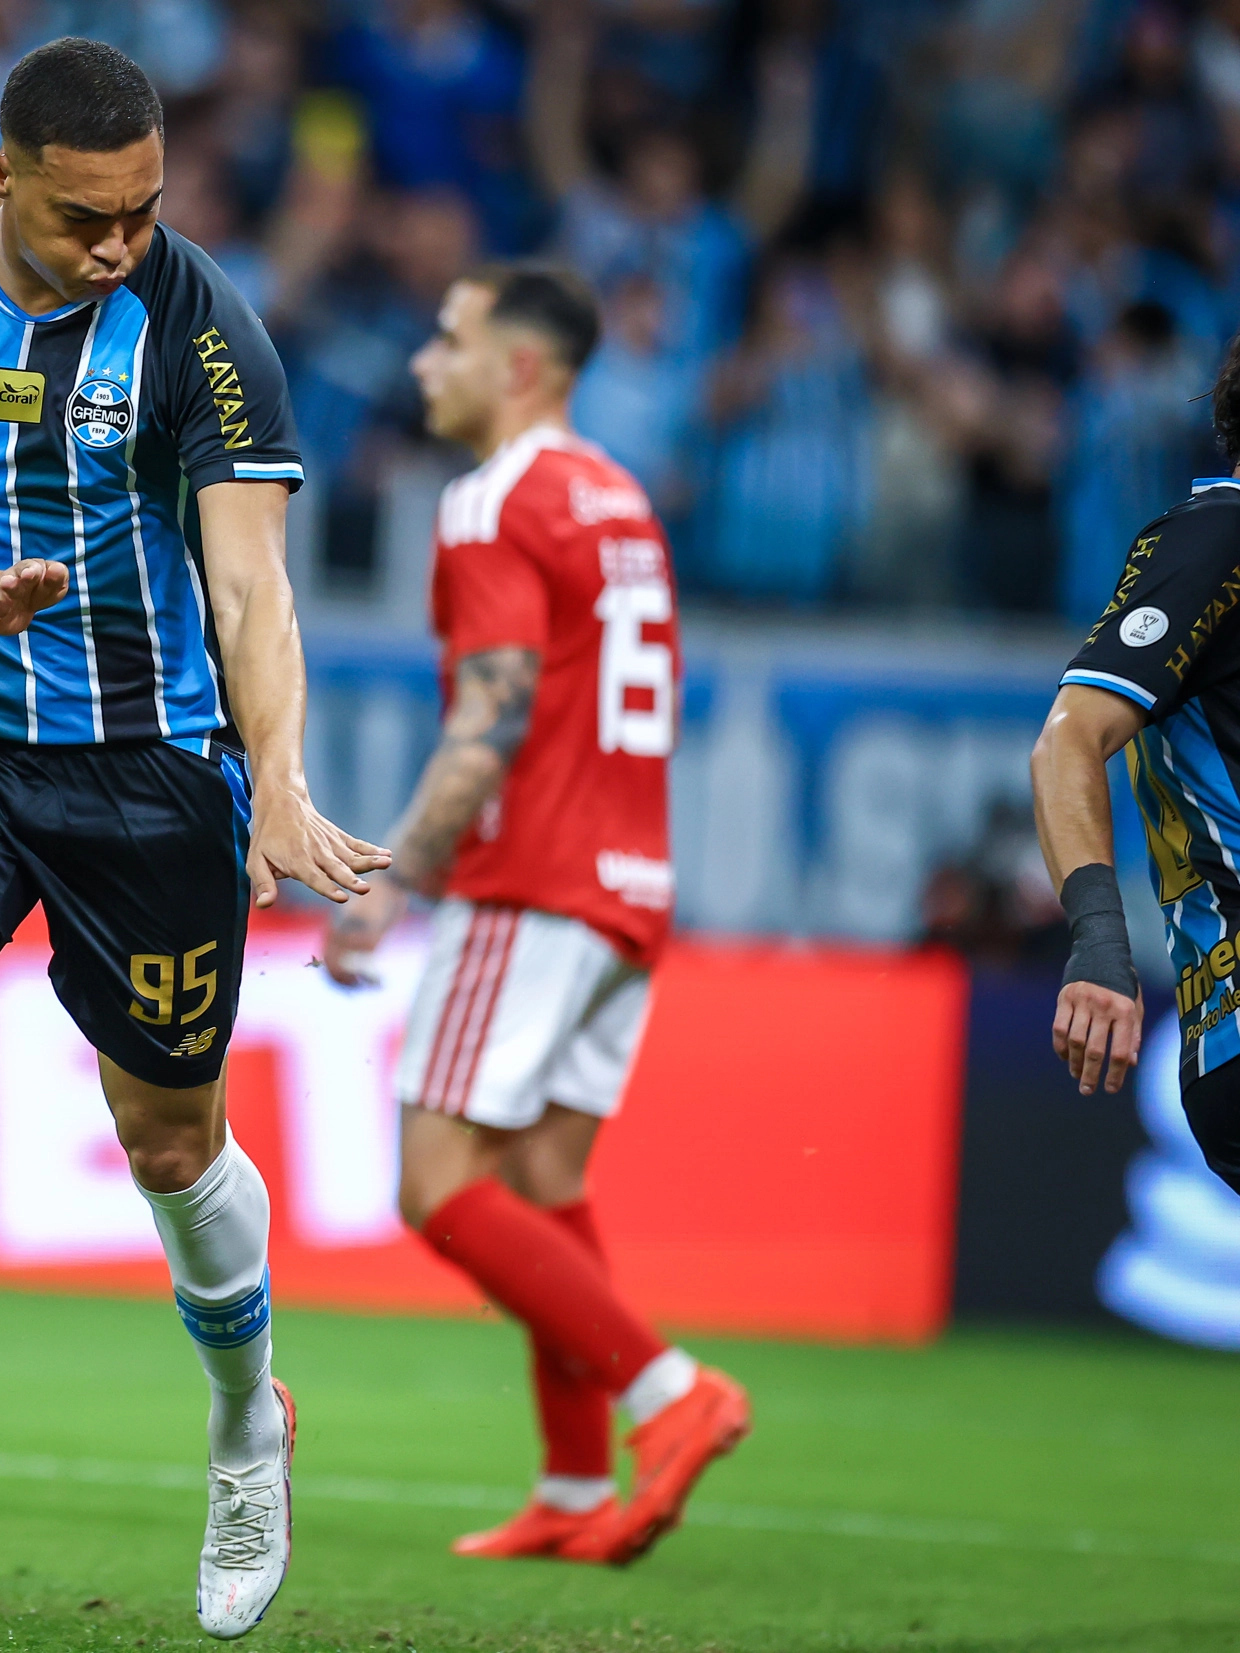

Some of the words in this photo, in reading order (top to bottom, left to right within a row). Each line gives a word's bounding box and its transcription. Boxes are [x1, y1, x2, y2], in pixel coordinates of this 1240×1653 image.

[95, 392, 110, 401] 1903
[192, 326, 253, 451] HAVAN
[72, 405, 129, 425] GRÊMIO
[91, 427, 106, 435] FBPA
[592, 583, 672, 756] 15
[128, 940, 217, 1026] 95
[1186, 1010, 1219, 1046] Porto
